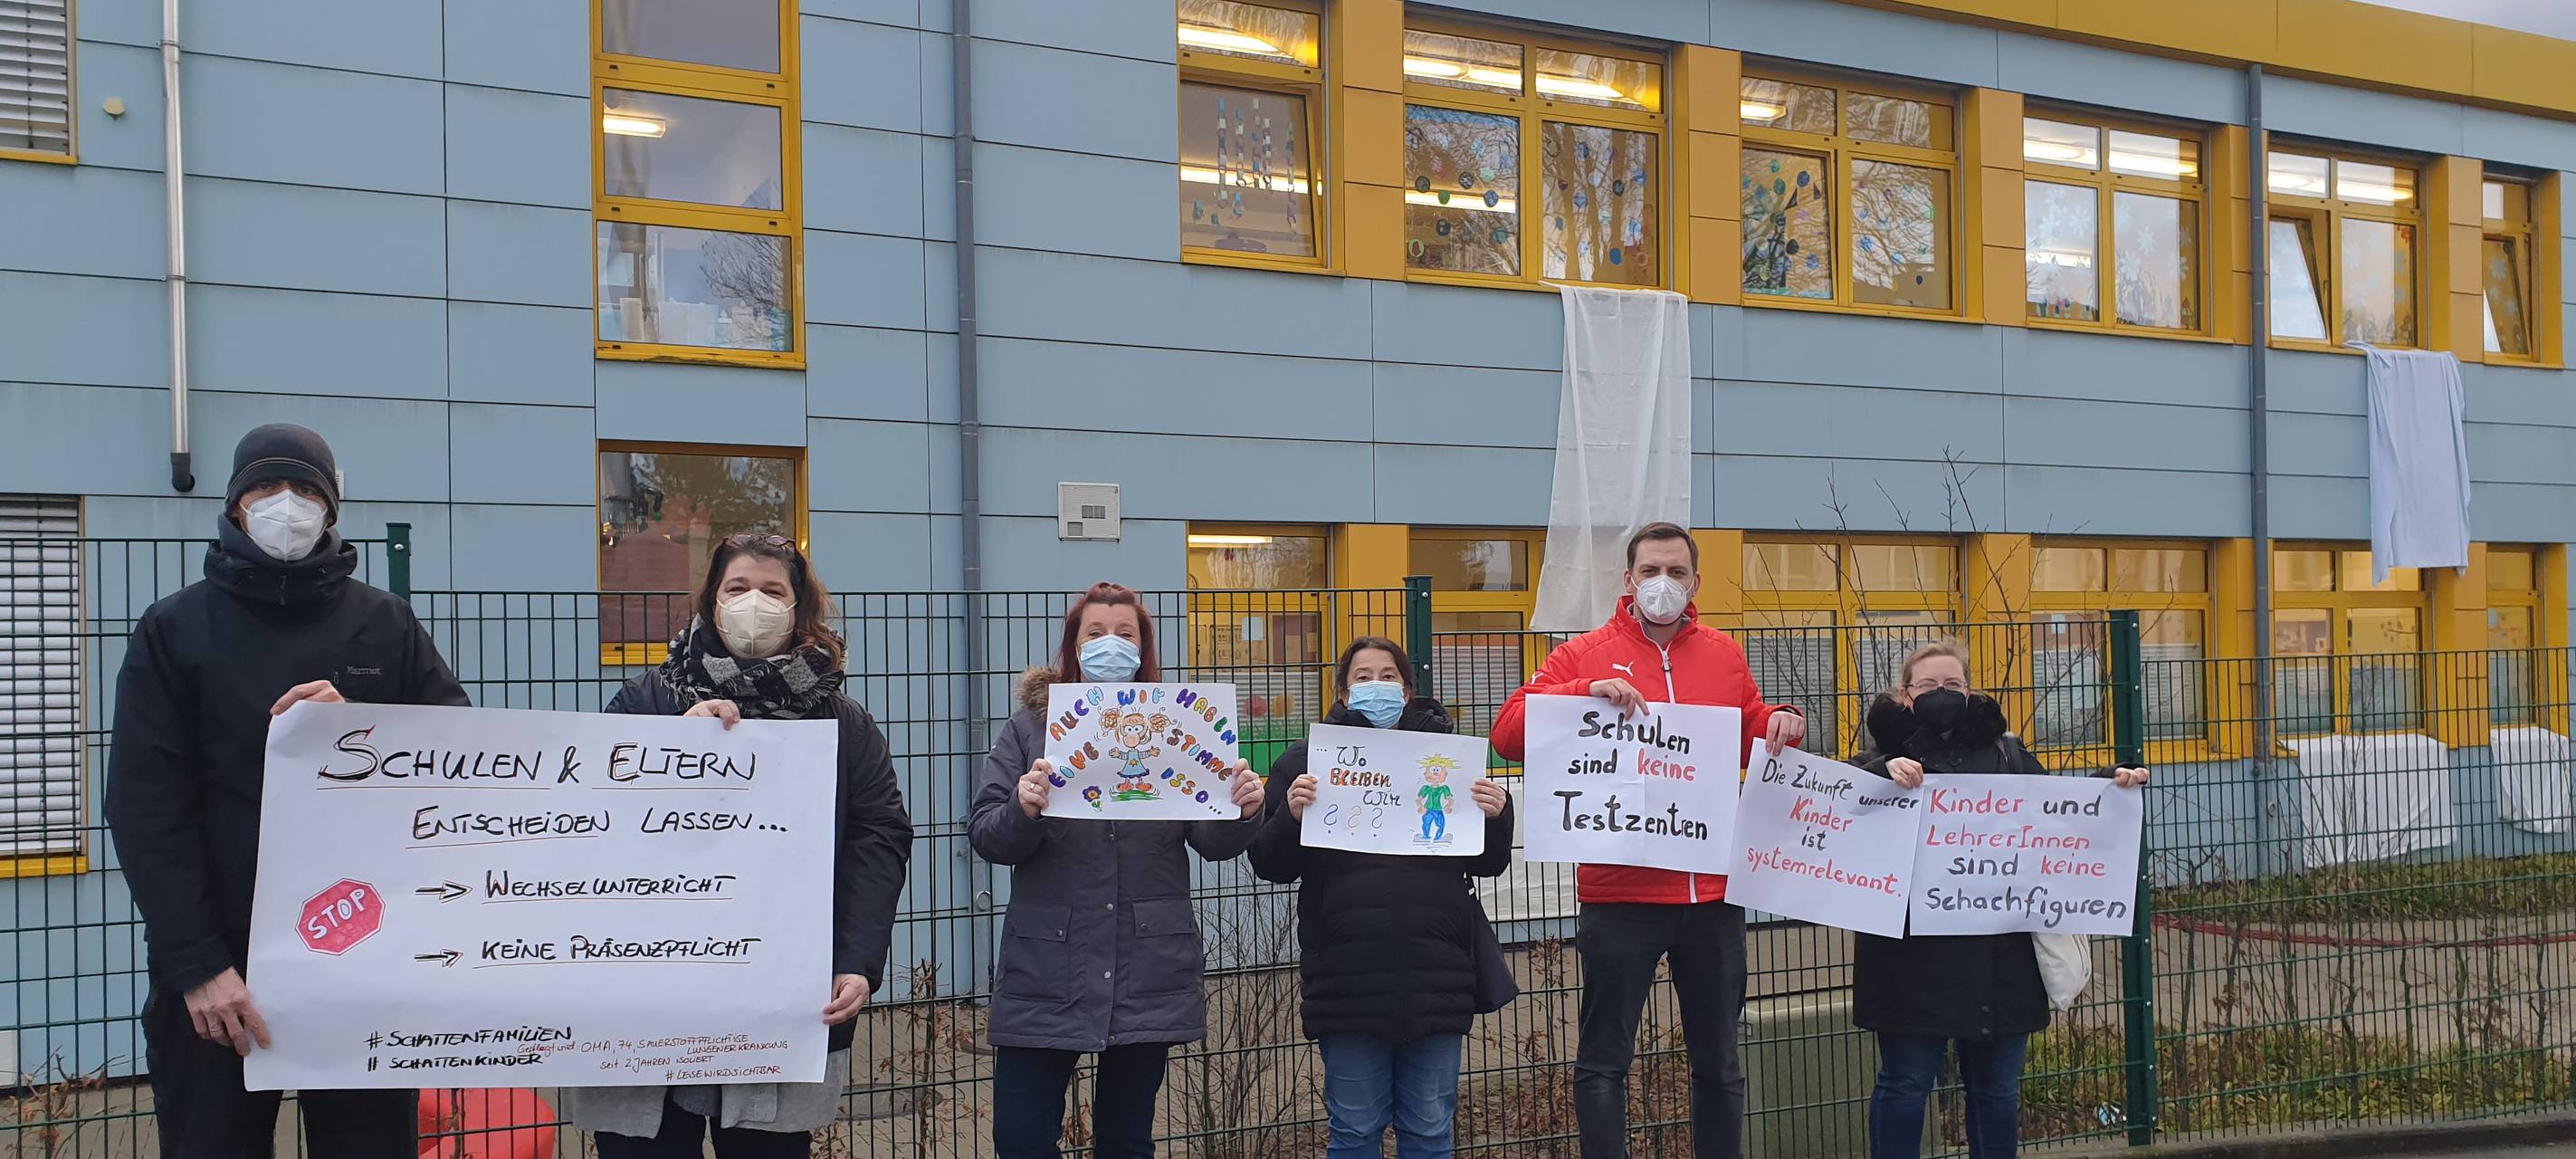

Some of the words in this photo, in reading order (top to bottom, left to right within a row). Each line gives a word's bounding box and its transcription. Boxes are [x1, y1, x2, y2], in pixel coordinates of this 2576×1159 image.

[1049, 686, 1104, 742] AUCH
[1176, 688, 1236, 745] HABEN
[1578, 711, 1690, 755] Schulen
[317, 724, 542, 782] SCHULEN
[557, 746, 581, 783] &
[608, 742, 757, 784] ELTERN
[1048, 742, 1100, 788] EINE
[1166, 728, 1234, 781] STIMME
[1568, 748, 1617, 775] sind
[1637, 748, 1696, 781] keine
[1761, 758, 1787, 785] Die
[1791, 764, 1854, 800] Zukunft
[1858, 795, 1921, 809] unserer
[1930, 788, 2024, 813] Kinder
[2043, 794, 2101, 817] und
[1553, 790, 1708, 840] Testzentren
[1789, 795, 1854, 832] Kinder
[1801, 826, 1827, 851] ist
[1926, 824, 2090, 849] LehrerInnen
[1747, 847, 1902, 897] systemrelevant.
[1946, 849, 2018, 876] sind
[2041, 853, 2106, 876] keine
[308, 888, 366, 939] STOP
[1925, 885, 2126, 928] Schachfiguren
[482, 938, 558, 962] KEINE
